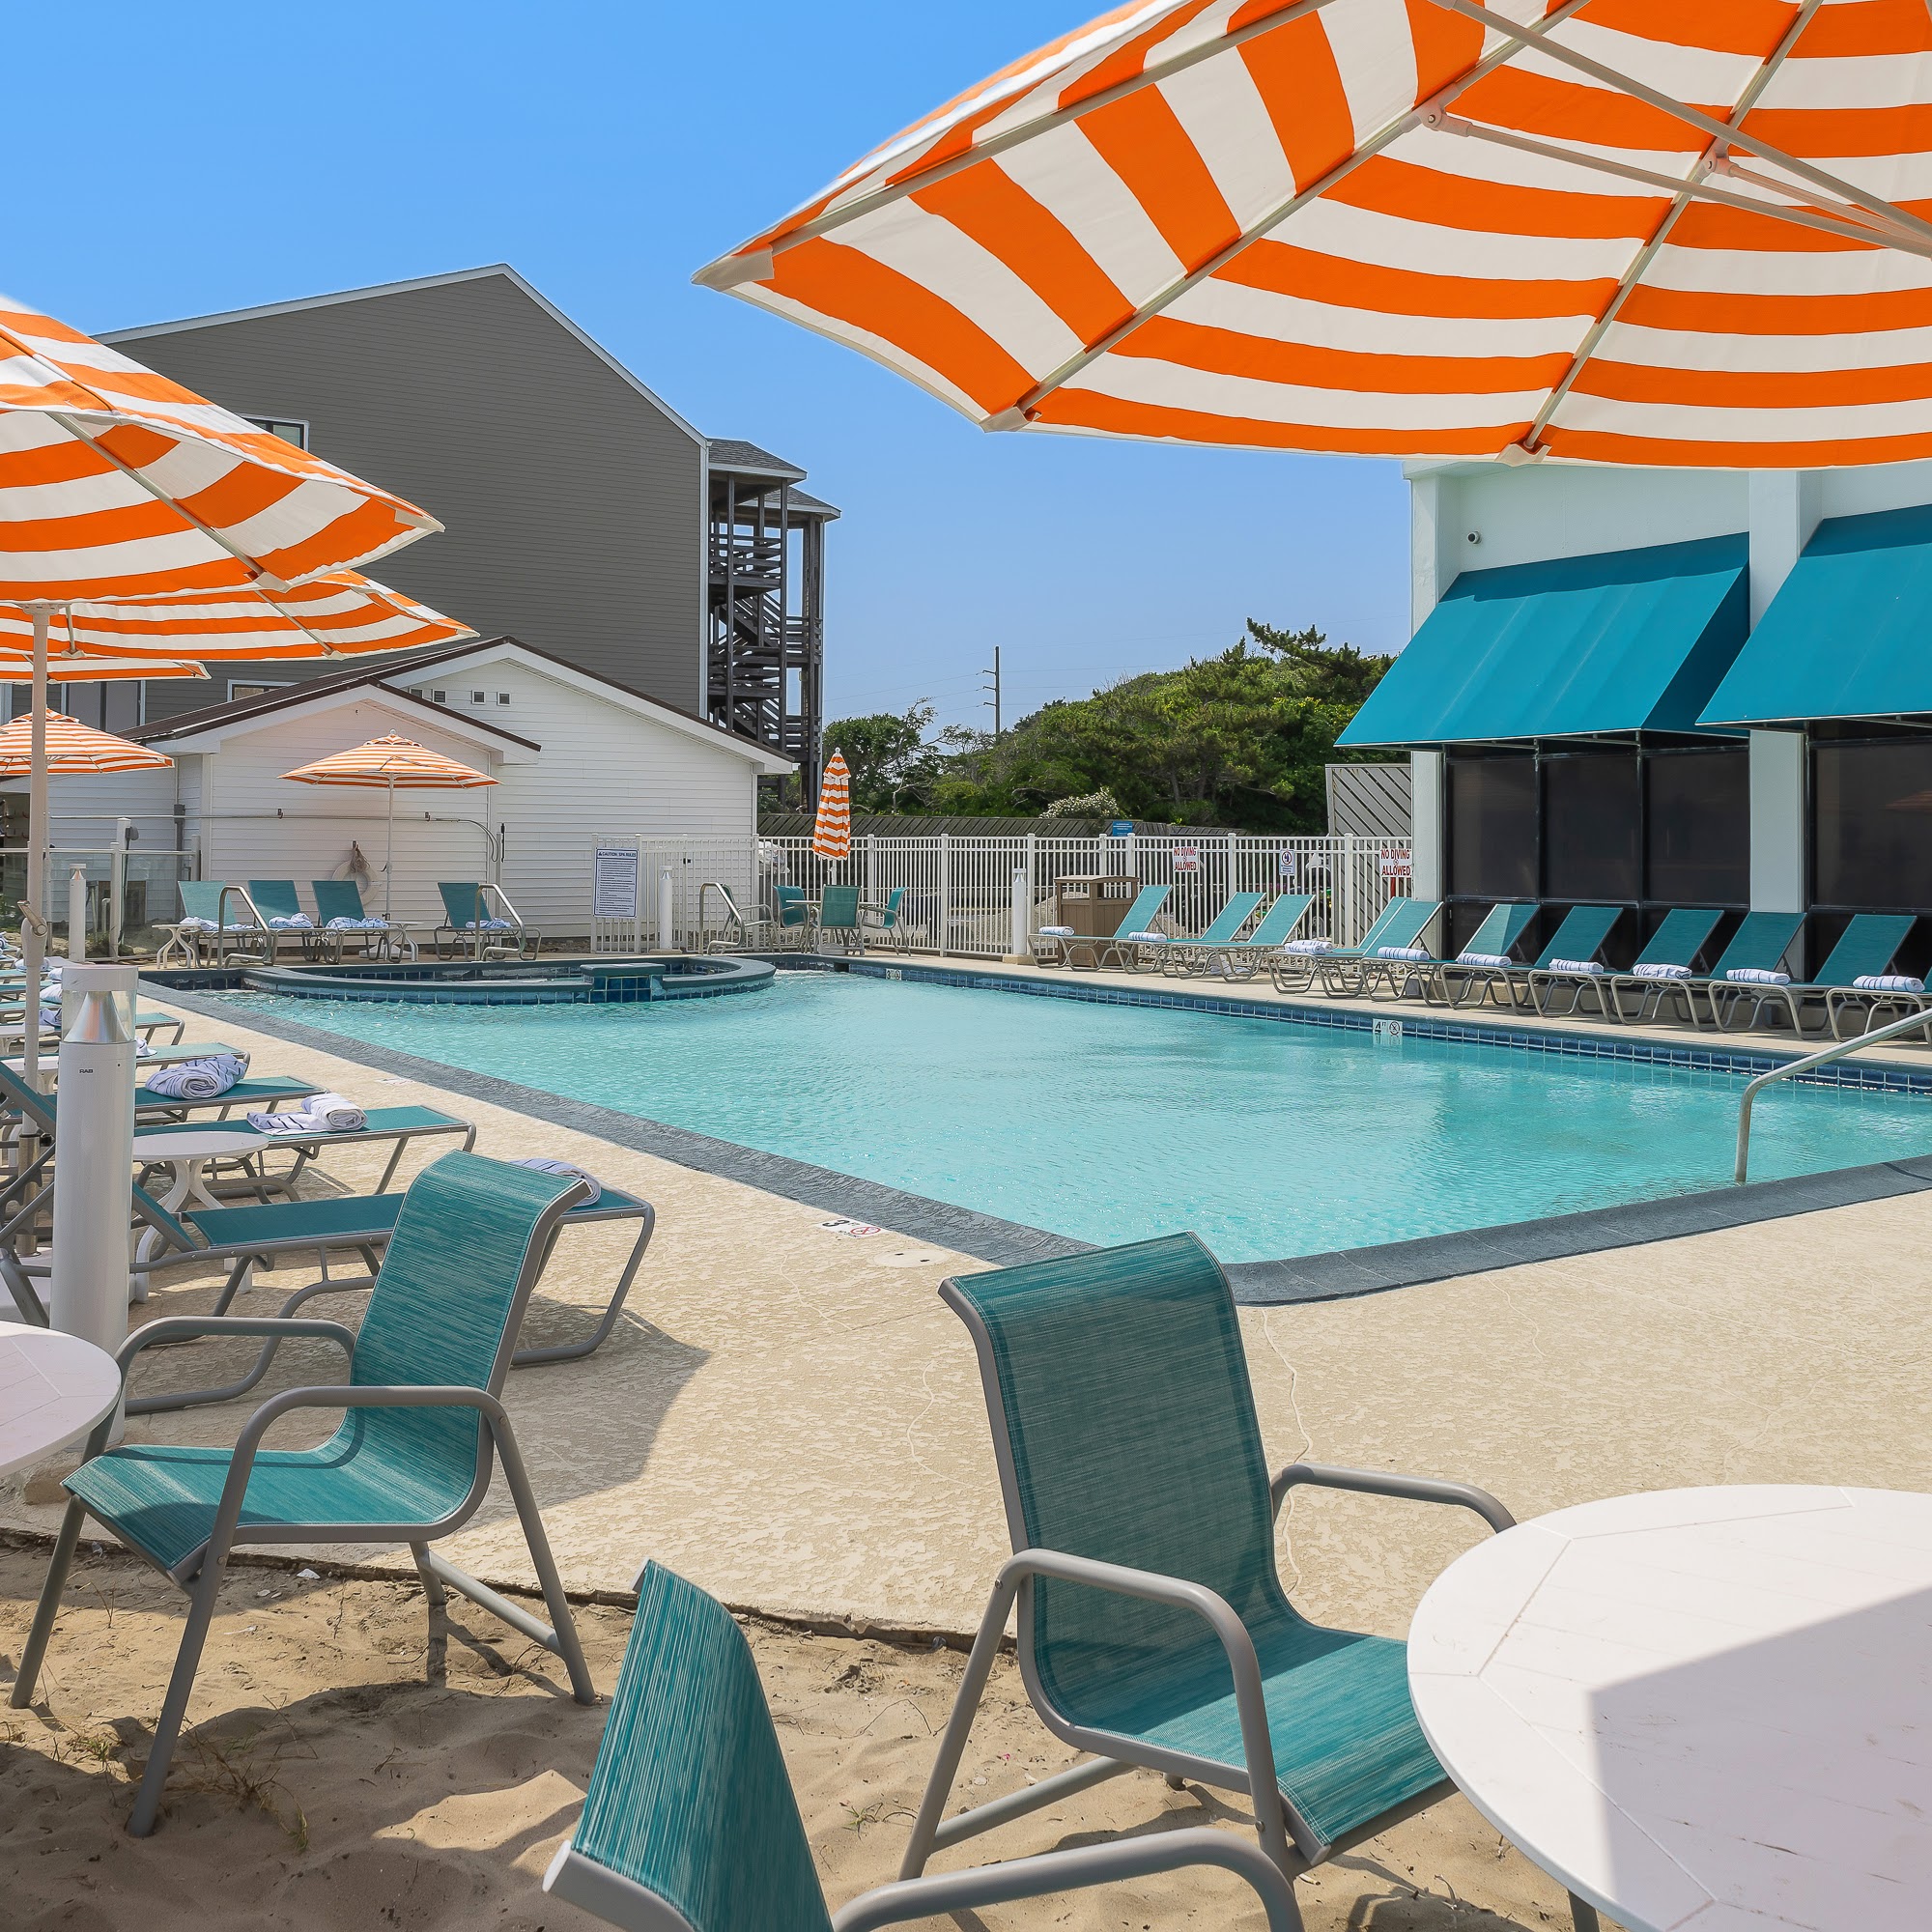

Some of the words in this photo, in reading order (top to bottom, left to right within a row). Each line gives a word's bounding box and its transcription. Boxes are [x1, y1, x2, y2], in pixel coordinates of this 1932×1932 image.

[1174, 847, 1179, 856] NO
[1181, 847, 1196, 856] DIVING
[1380, 849, 1389, 859] NO
[1391, 849, 1409, 859] DIVING
[1175, 862, 1196, 870] ALLOWED
[1382, 866, 1410, 875] ALLOWED
[1375, 1021, 1381, 1033] 4
[822, 1219, 850, 1228] 3
